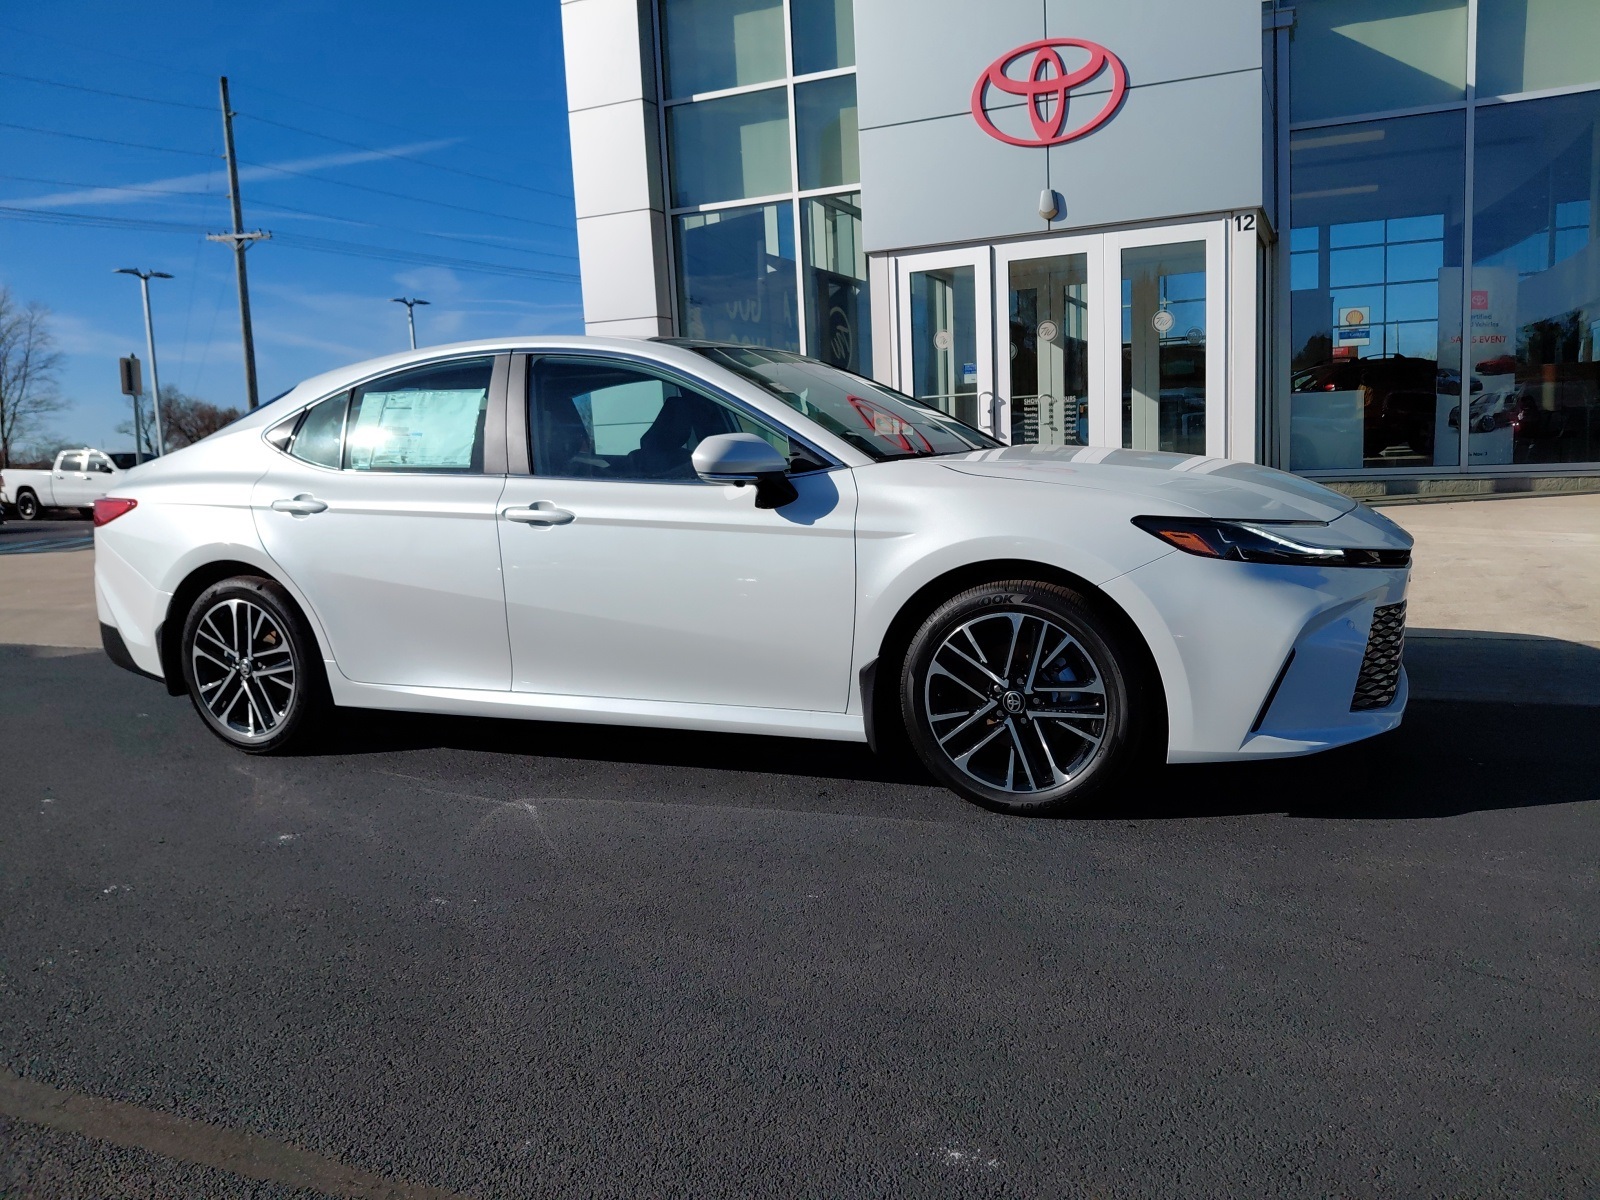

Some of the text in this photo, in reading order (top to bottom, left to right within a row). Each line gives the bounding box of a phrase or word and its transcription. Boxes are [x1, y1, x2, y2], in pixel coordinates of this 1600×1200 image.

[1235, 214, 1255, 231] 12
[1450, 335, 1507, 343] SAS EVENT
